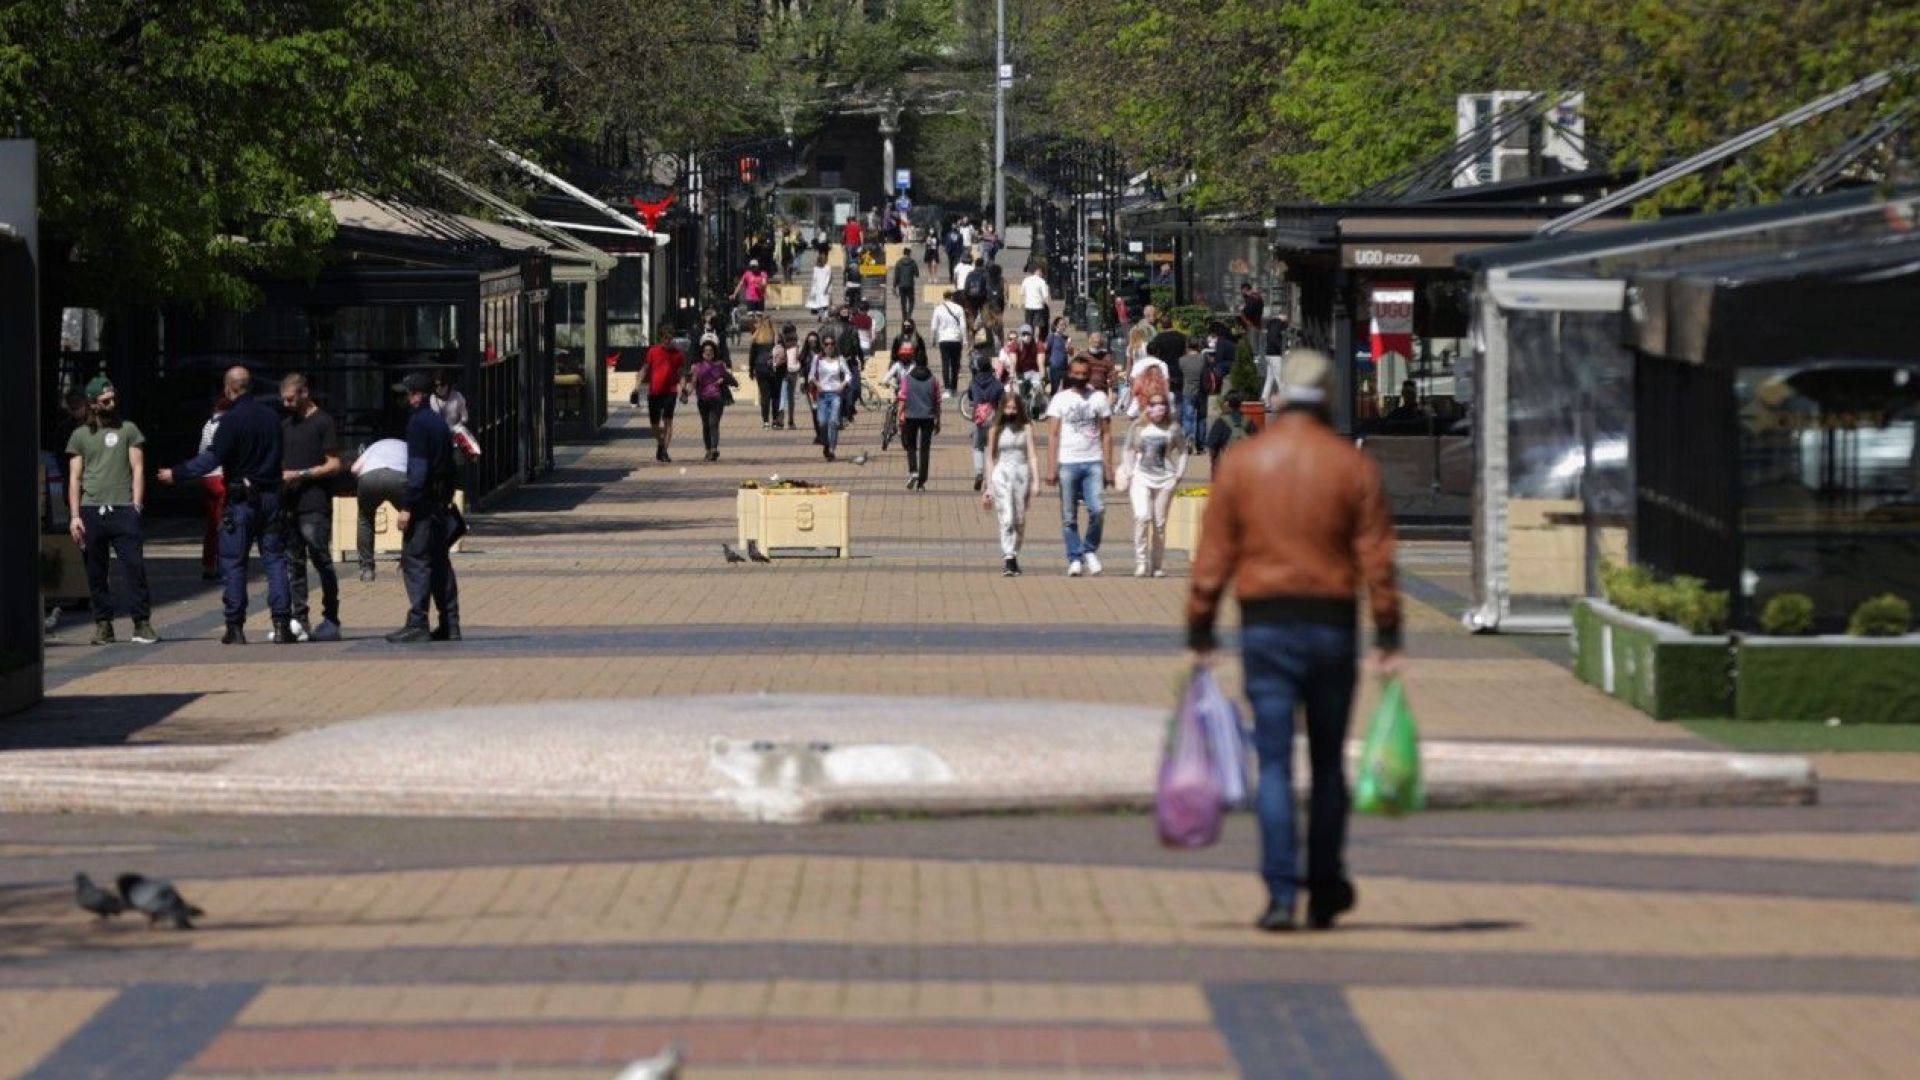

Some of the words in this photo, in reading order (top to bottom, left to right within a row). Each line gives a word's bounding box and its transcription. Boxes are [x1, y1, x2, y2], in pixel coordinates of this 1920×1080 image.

[1355, 250, 1382, 264] UGO
[1385, 253, 1421, 264] PIZZA
[1375, 300, 1409, 318] UGO
